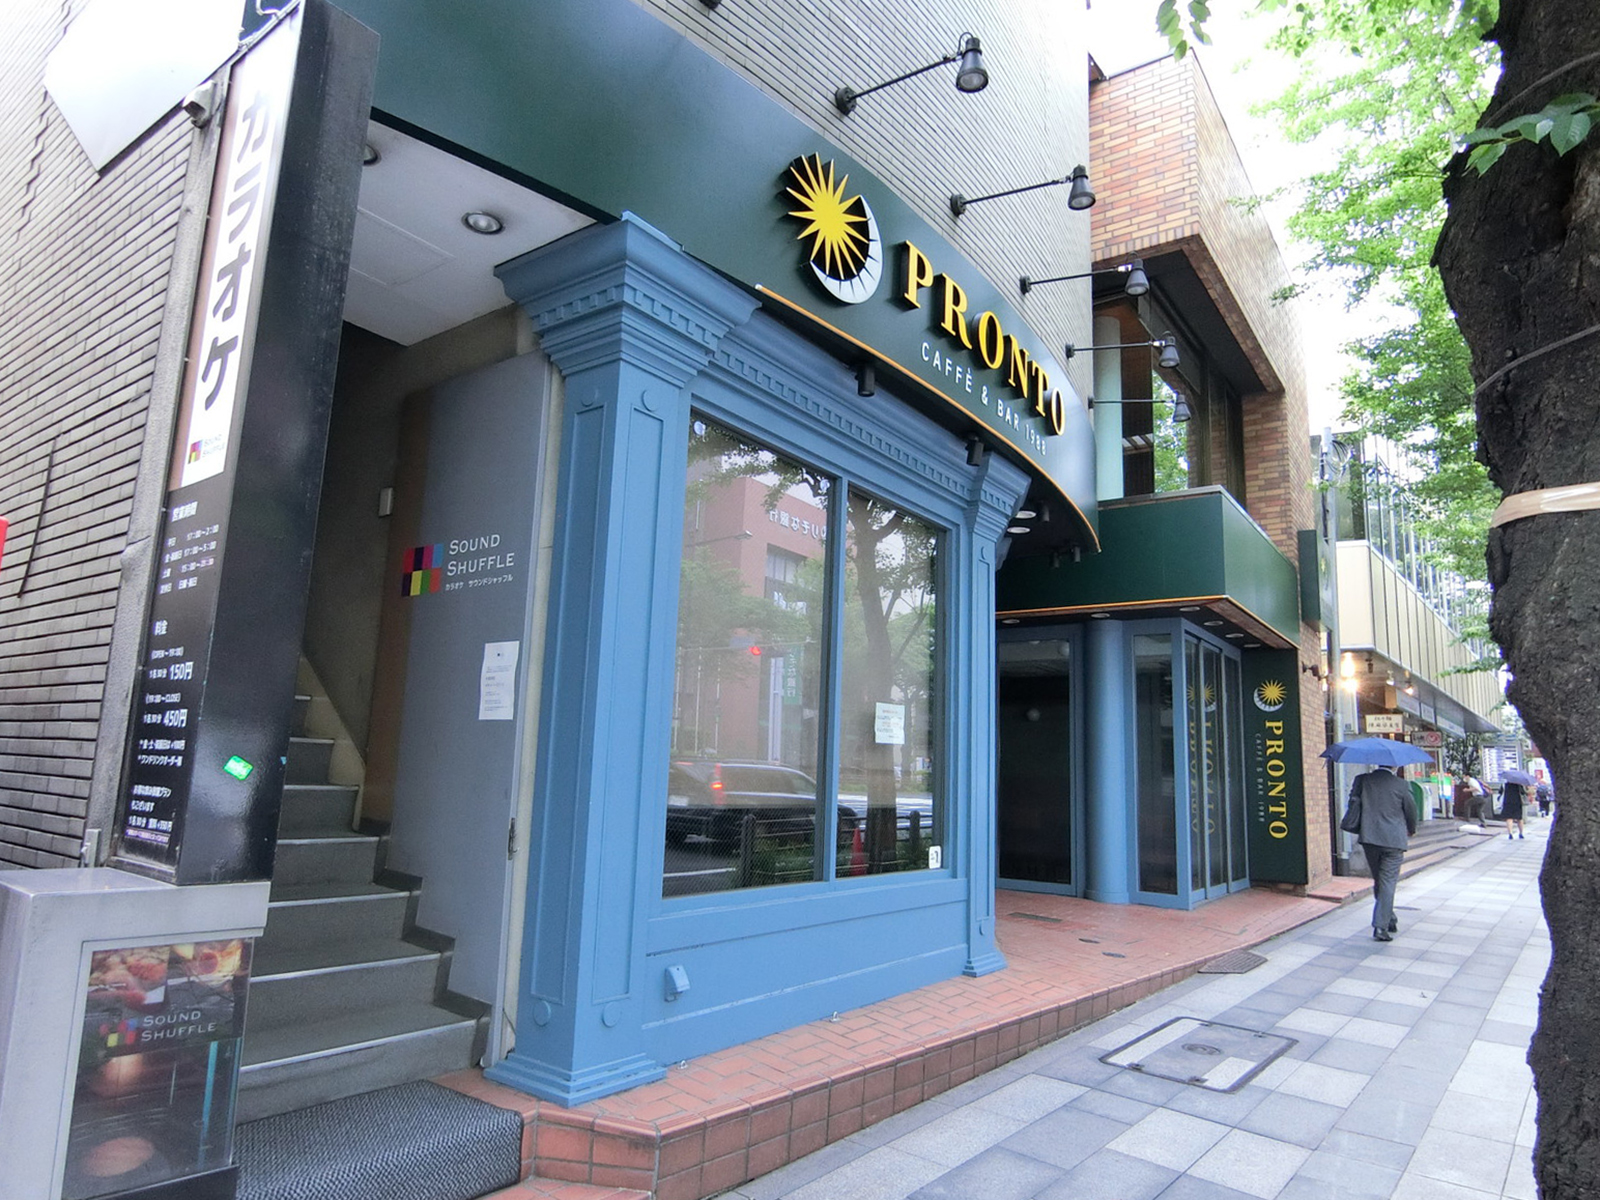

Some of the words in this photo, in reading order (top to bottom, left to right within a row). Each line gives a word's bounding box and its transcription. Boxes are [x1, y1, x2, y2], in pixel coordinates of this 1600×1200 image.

[202, 91, 270, 411] カラオケ
[904, 240, 1066, 437] PRONTO
[921, 341, 973, 394] CAFFÈ
[980, 385, 990, 406] &
[997, 398, 1020, 432] BAR
[1024, 422, 1047, 456] 1988
[449, 534, 500, 555] SOUND
[447, 552, 515, 576] SHUFFLE
[445, 581, 464, 591] カラオケ
[169, 661, 194, 680] 150円
[162, 709, 188, 728] 450円
[1265, 720, 1289, 839] PRONTO
[143, 1010, 201, 1027] SOUND
[141, 1022, 217, 1042] SHUFFLE
